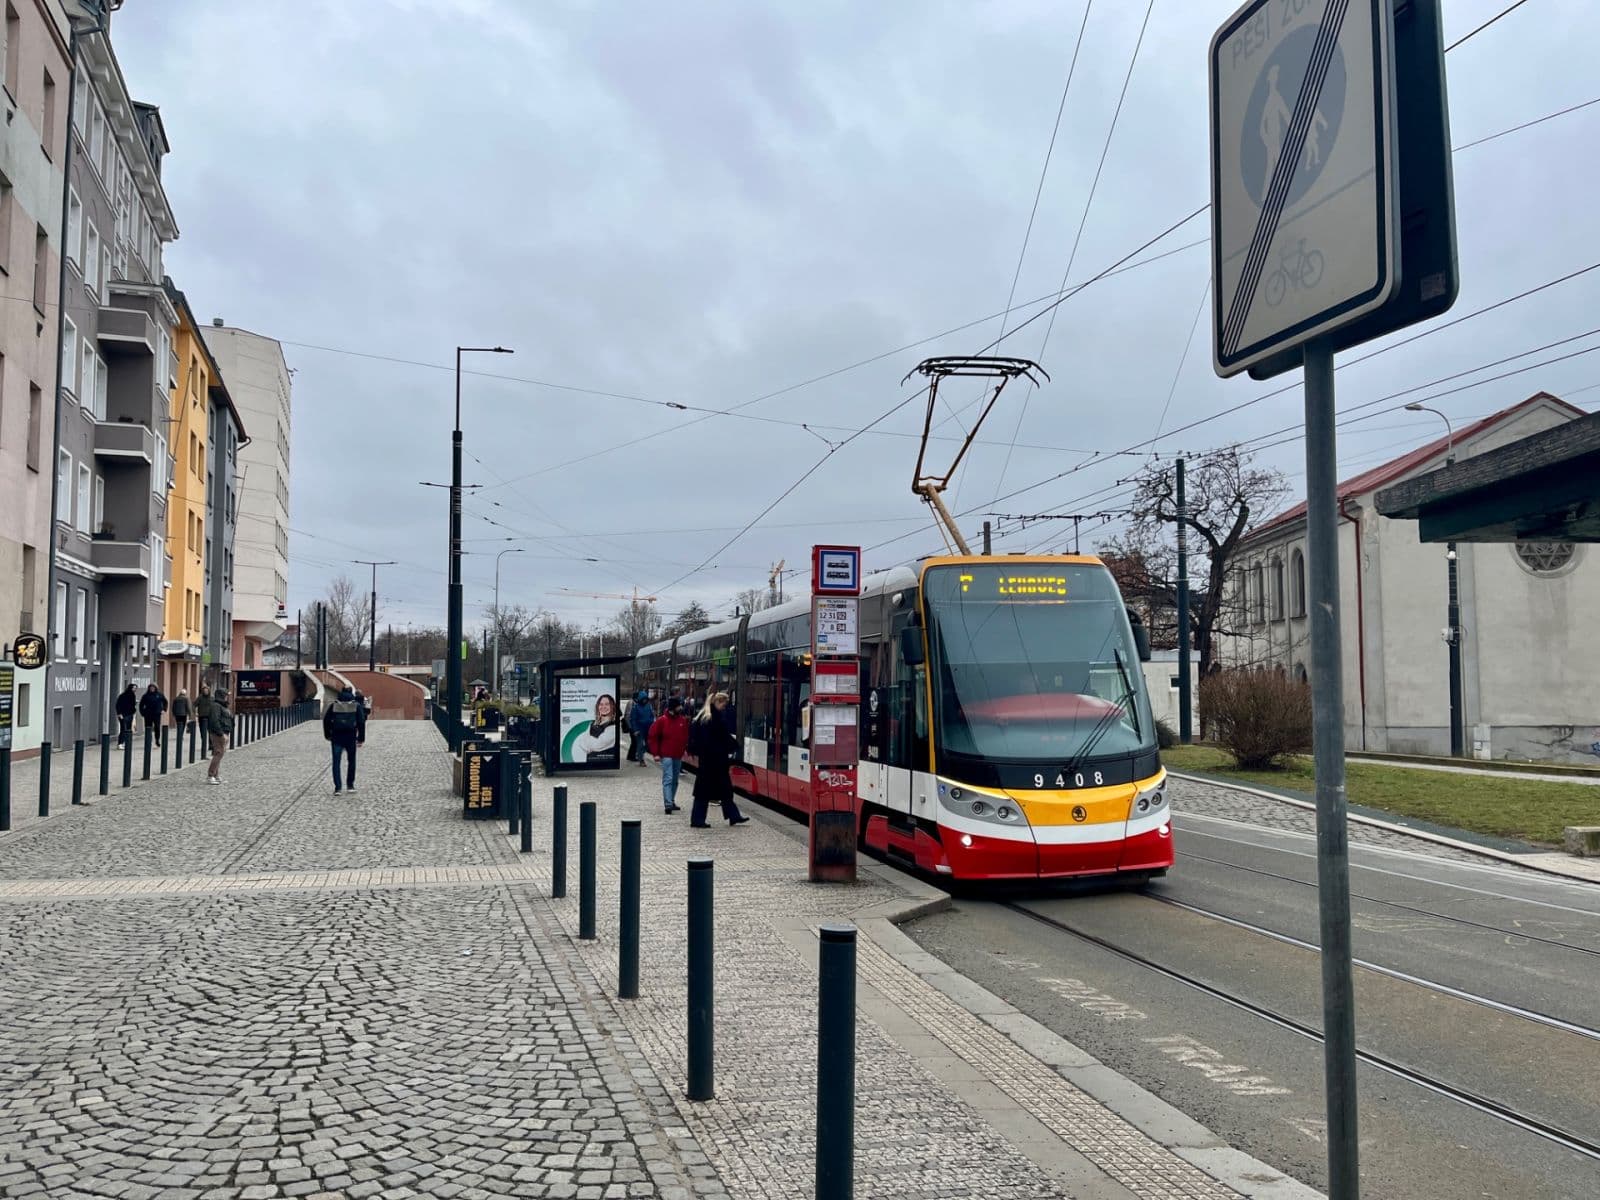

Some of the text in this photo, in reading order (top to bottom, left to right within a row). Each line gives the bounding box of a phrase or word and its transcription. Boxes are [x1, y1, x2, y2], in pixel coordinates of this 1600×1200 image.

[999, 577, 1066, 594] LEHOVEC
[468, 755, 481, 808] PALMOVKA
[1034, 771, 1104, 788] 9408
